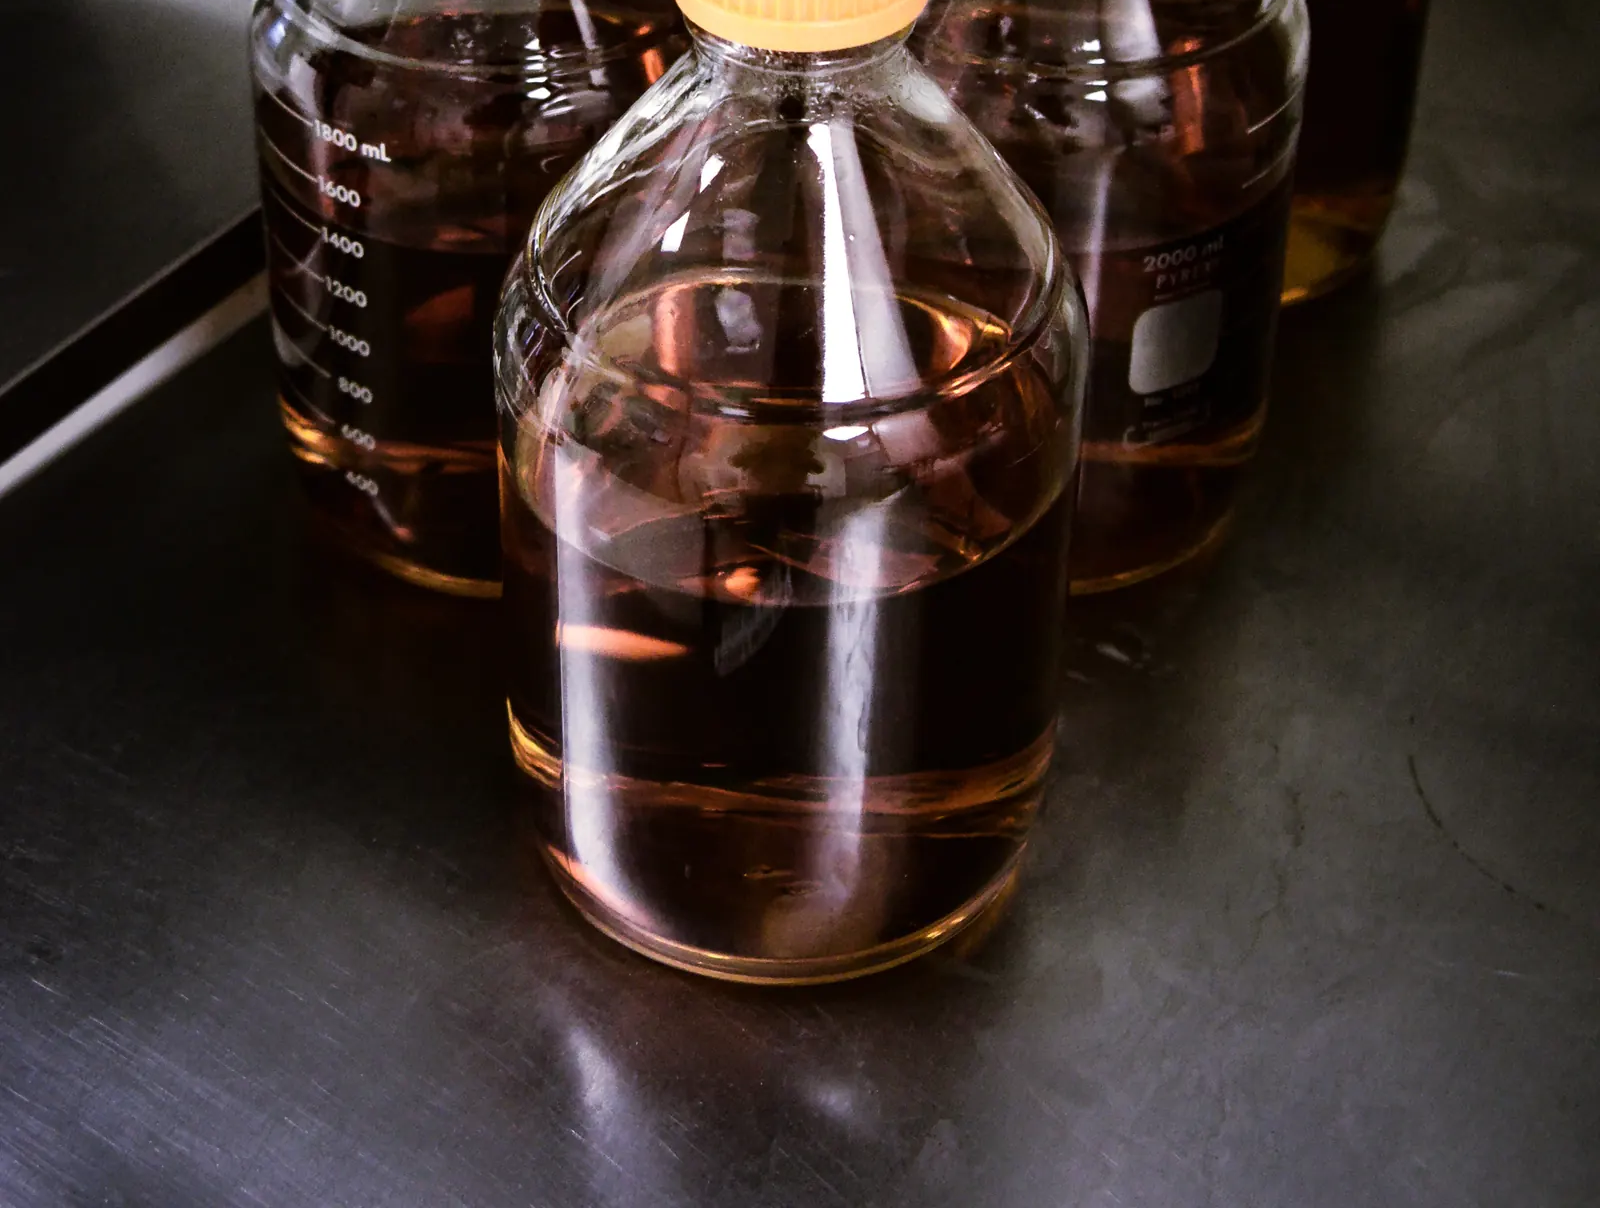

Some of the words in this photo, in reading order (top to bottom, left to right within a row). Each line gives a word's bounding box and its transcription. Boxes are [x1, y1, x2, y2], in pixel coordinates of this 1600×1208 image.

[314, 119, 357, 152] 1800
[361, 142, 392, 163] mL
[317, 174, 361, 207] 1600
[321, 226, 364, 259] 1400
[1144, 244, 1198, 272] 2000
[325, 275, 369, 308] 1200
[328, 324, 371, 357] 1000
[337, 375, 374, 404] 800
